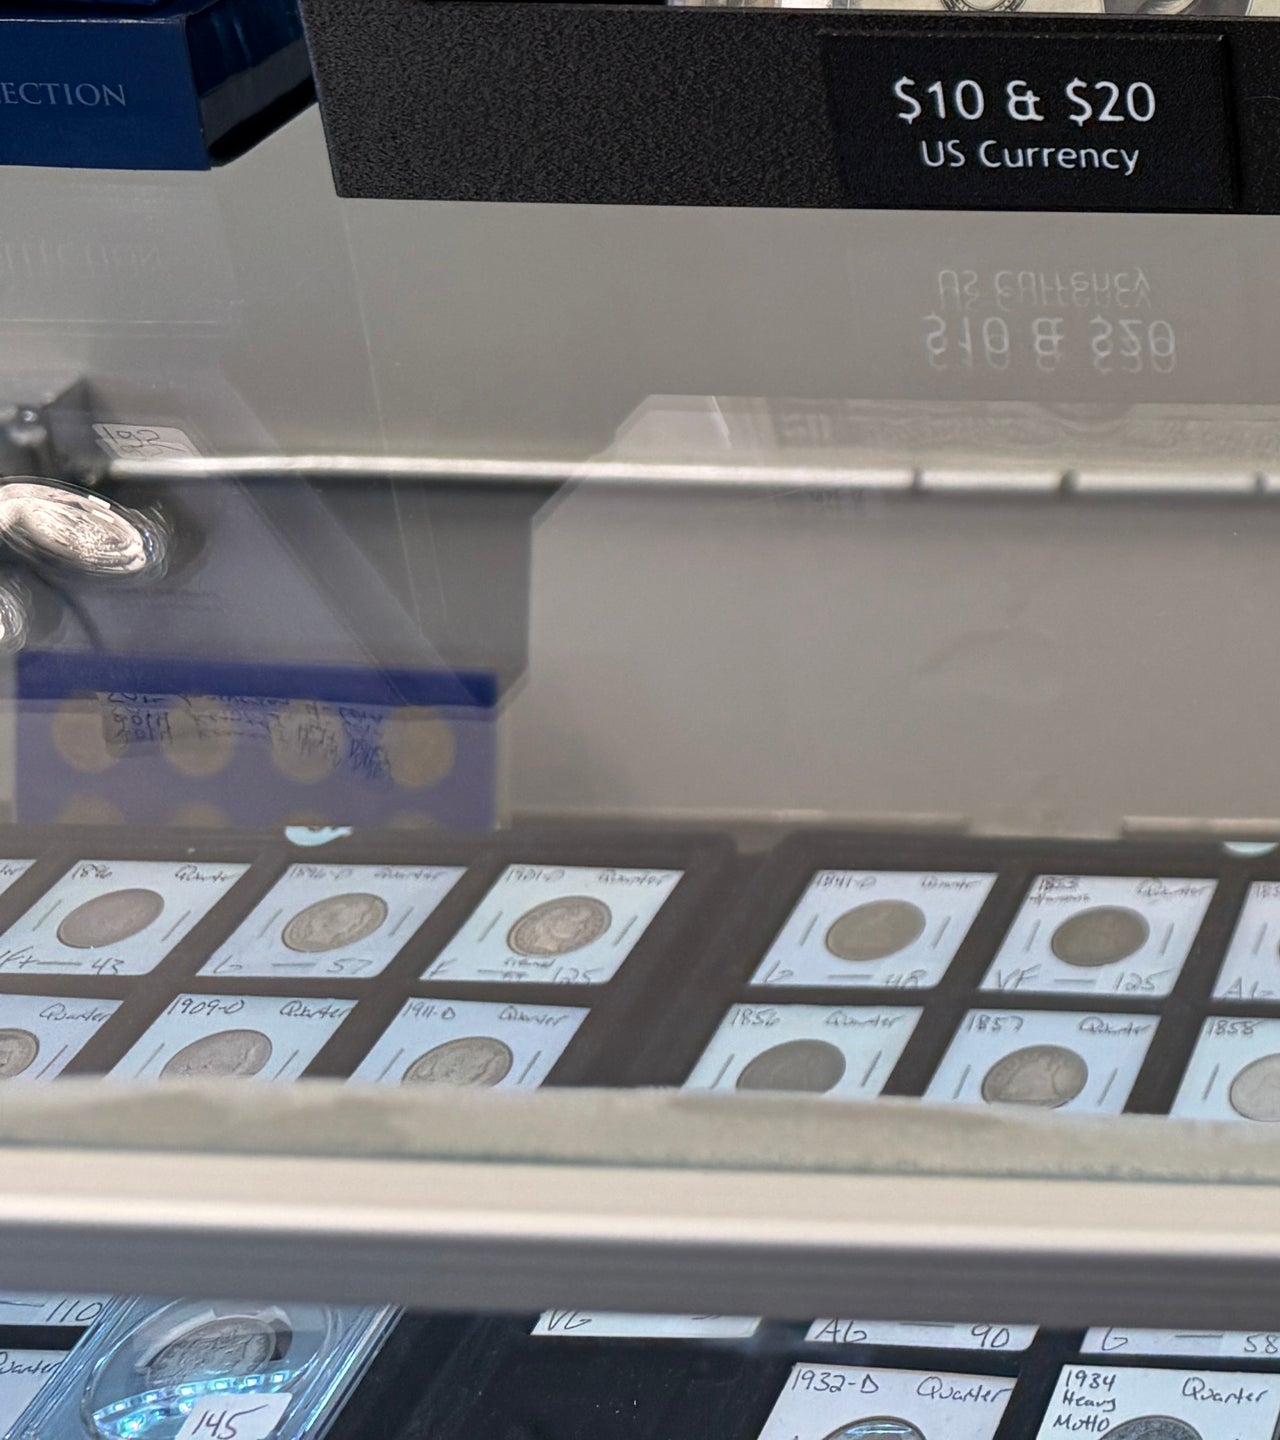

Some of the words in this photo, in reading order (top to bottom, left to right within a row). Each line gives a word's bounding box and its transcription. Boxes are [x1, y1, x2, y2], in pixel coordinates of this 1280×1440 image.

[0, 81, 126, 107] ECTION
[894, 76, 985, 124] $10
[1006, 80, 1044, 121] &
[1065, 77, 1155, 126] $20
[922, 139, 966, 168] US
[980, 140, 1140, 176] Currency
[45, 1299, 101, 1322] 110
[971, 1325, 1011, 1348] 90
[1243, 1336, 1280, 1354] 58
[791, 1369, 881, 1394] 1932-D
[917, 1377, 1015, 1405] Quarter
[1065, 1370, 1117, 1391] 1934
[1183, 1377, 1269, 1405] Quarter
[192, 1404, 268, 1438] 145
